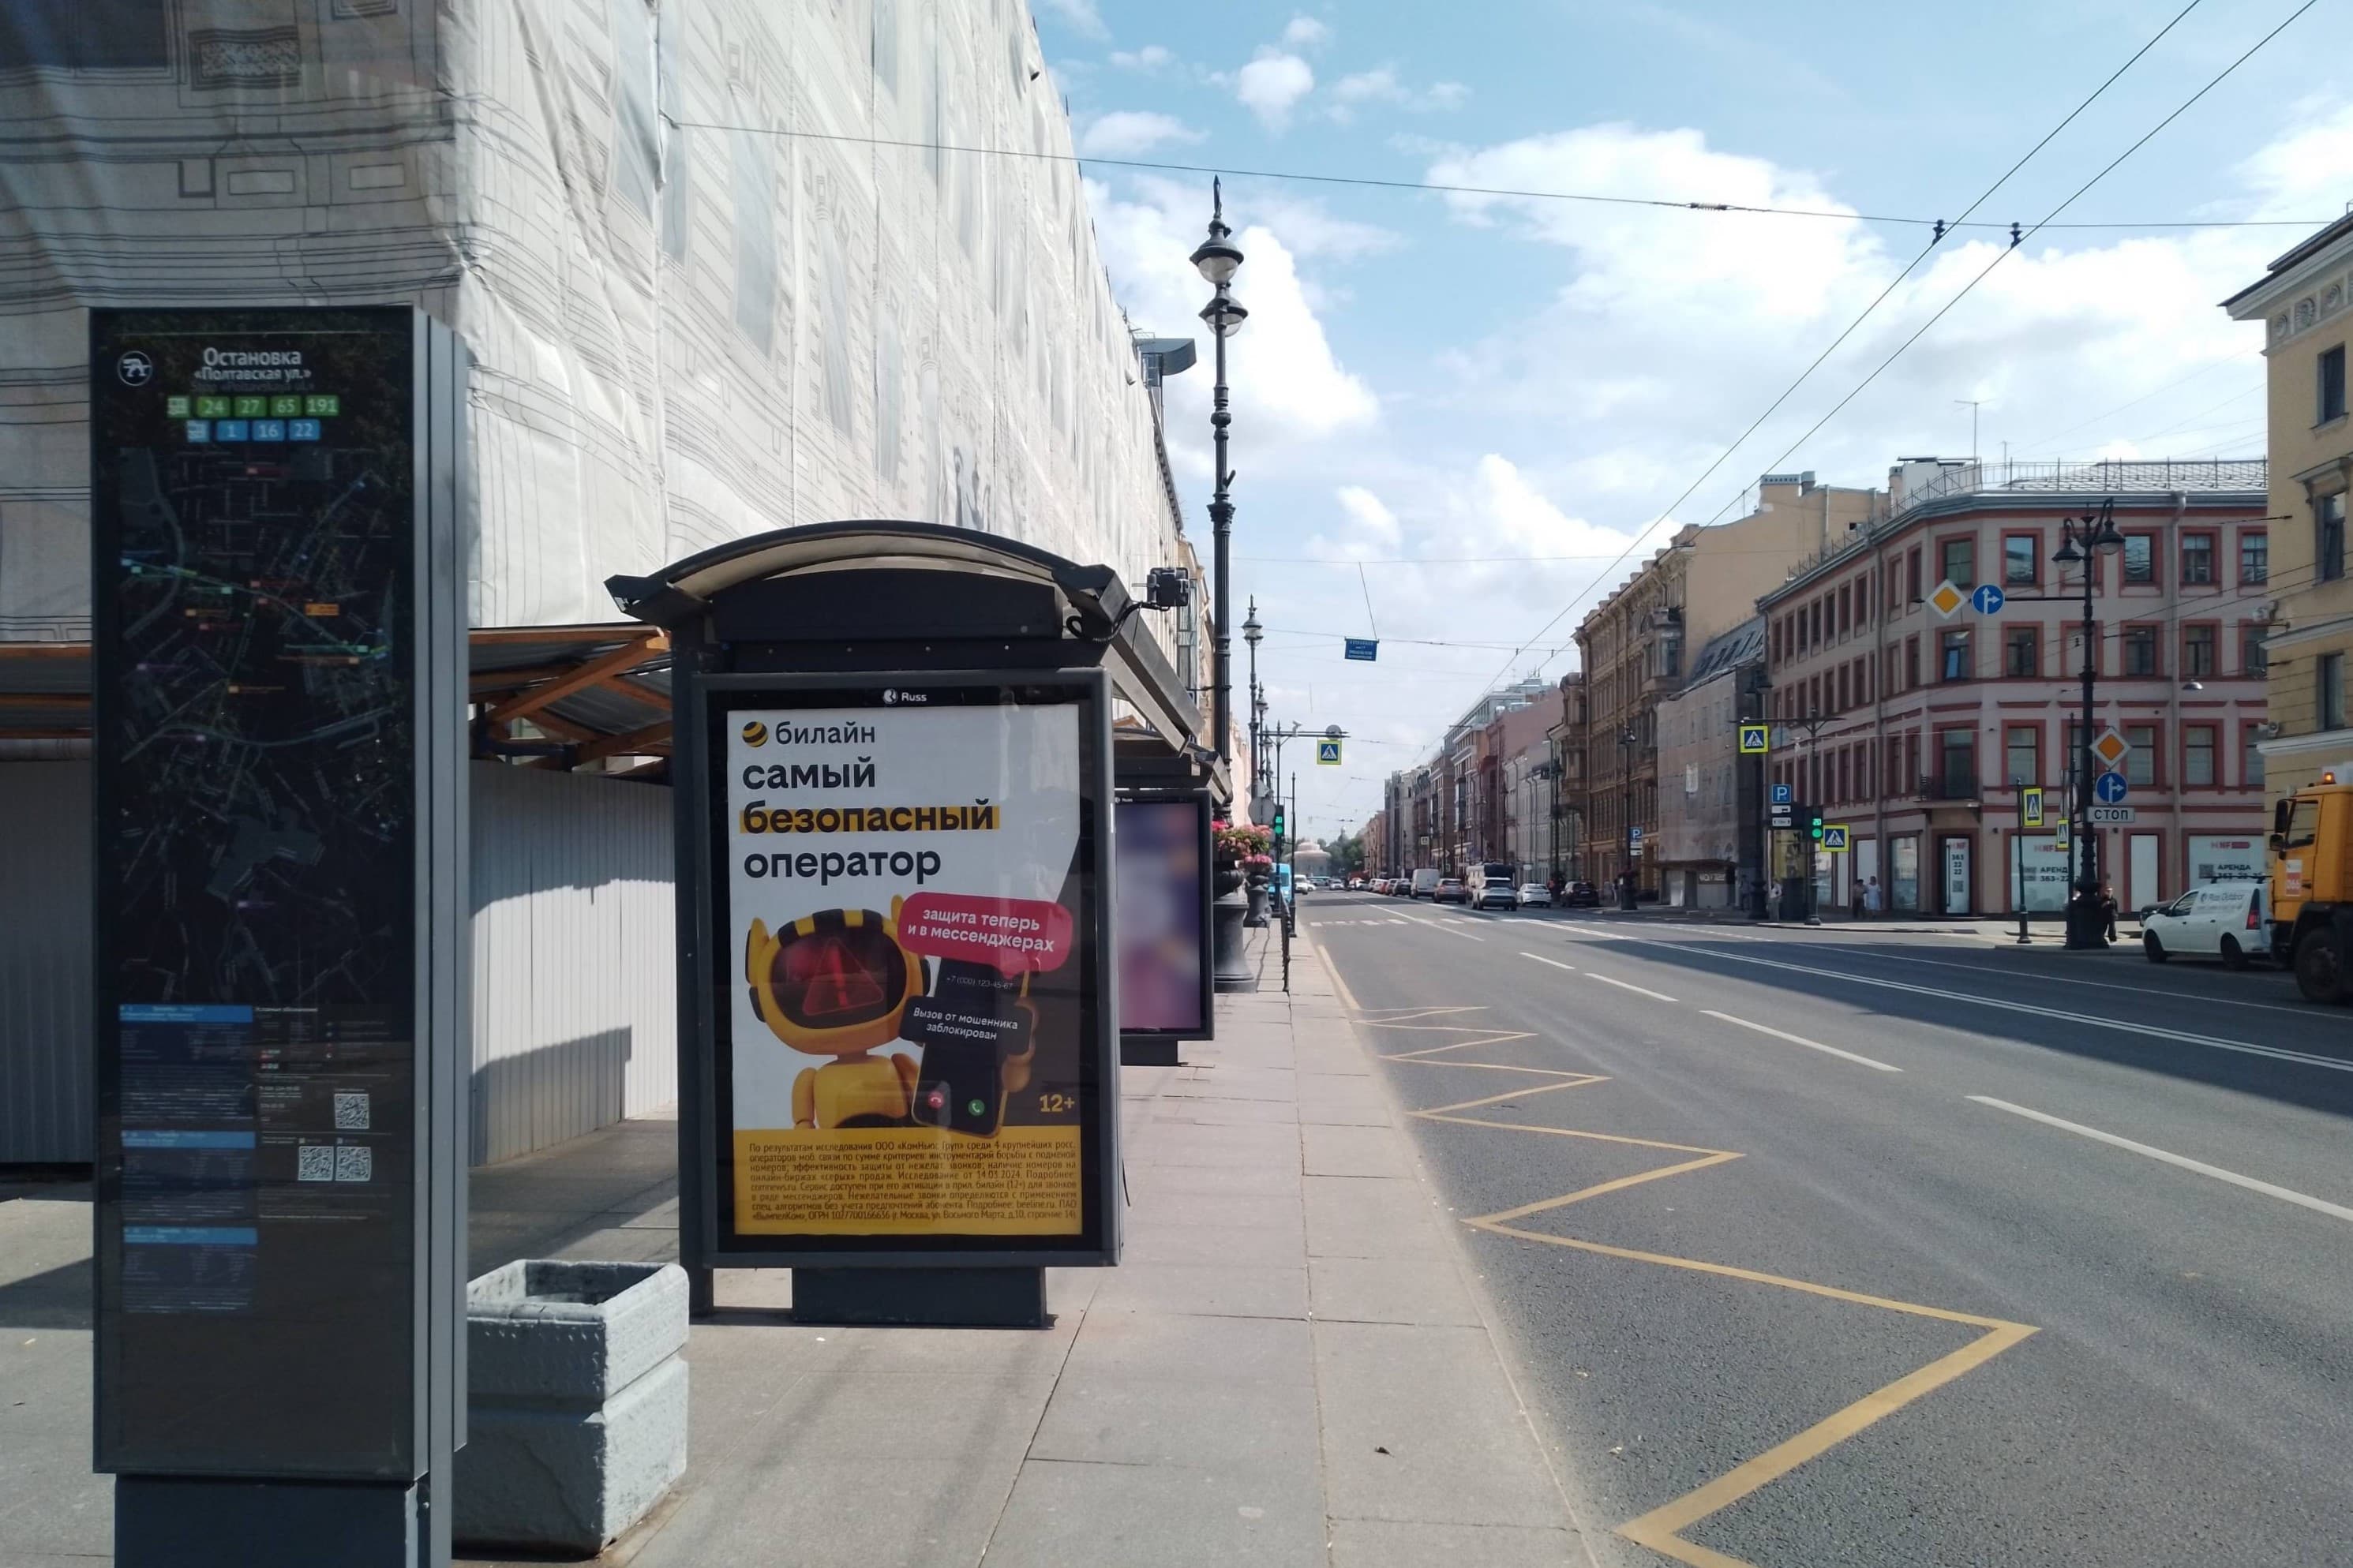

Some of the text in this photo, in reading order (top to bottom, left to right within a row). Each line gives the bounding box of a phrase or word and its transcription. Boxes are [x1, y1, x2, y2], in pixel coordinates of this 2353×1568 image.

[203, 347, 302, 366] Остановка
[194, 366, 281, 380] «Полтавская
[204, 398, 337, 414] 24 27 65 191
[227, 423, 313, 438] 1 16 22
[901, 692, 927, 702] Russ
[775, 721, 876, 745] билайн
[743, 756, 876, 790] самый
[1777, 787, 1788, 801] P
[744, 798, 994, 833] безопасный
[2094, 810, 2129, 820] СТОП
[1633, 829, 1640, 839] P
[744, 851, 942, 885] оператор
[923, 907, 1040, 931] защита теперь
[908, 924, 1055, 953] и в мессенджерах
[913, 1007, 1018, 1030] Вызов от мошенника
[926, 1022, 998, 1040] заблокирован
[1040, 1094, 1075, 1113] 12+
[749, 1143, 760, 1152] По
[763, 1144, 813, 1153] результатам
[875, 1141, 894, 1150] ООО
[967, 1142, 991, 1151] среди
[1002, 1141, 1052, 1151] крупнейших
[750, 1154, 796, 1163] операторов
[856, 1153, 880, 1162] сумме
[996, 1150, 1026, 1160] борьбы
[1036, 1151, 1076, 1159] подменой
[792, 1163, 857, 1173] эффективность
[898, 1171, 959, 1181] Исследование
[800, 1182, 827, 1192] Сервис
[830, 1183, 867, 1192] доступен
[869, 1183, 884, 1192] при
[950, 1192, 1009, 1200] определяются
[1020, 1191, 1077, 1199] применением
[775, 1203, 822, 1211] алгоритмов
[866, 1200, 923, 1210] предпочтений
[1059, 1199, 1077, 1208] ПАО
[808, 1211, 829, 1219] ОГРН
[943, 1210, 980, 1218] Восьмого
